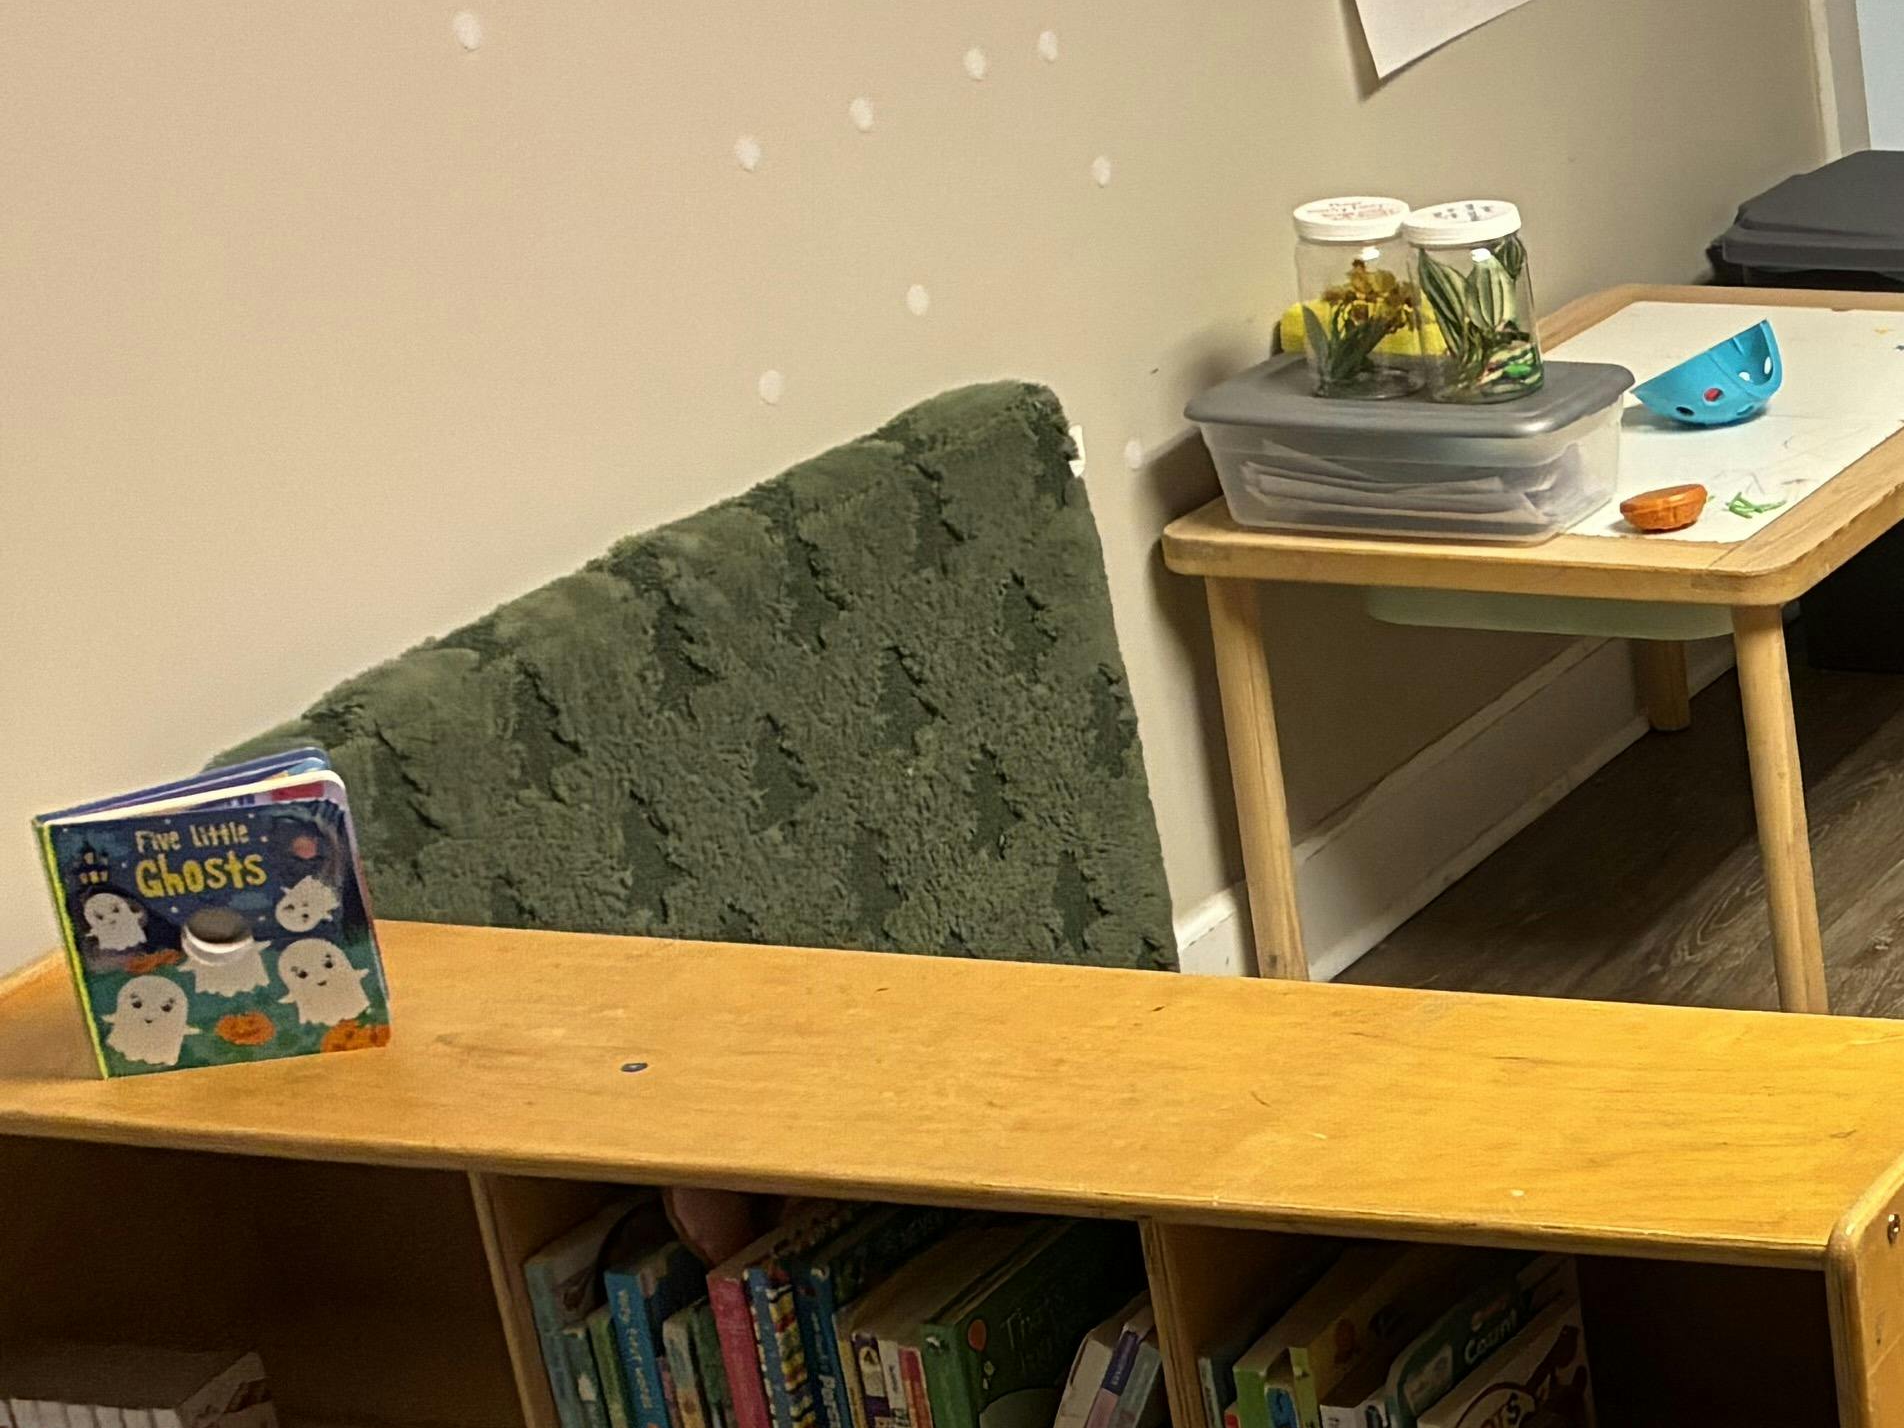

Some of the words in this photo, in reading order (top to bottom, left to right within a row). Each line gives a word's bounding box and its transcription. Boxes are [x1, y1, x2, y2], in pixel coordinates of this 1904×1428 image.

[134, 826, 183, 854] Five
[189, 821, 251, 849] Little
[134, 850, 269, 900] Ghosts
